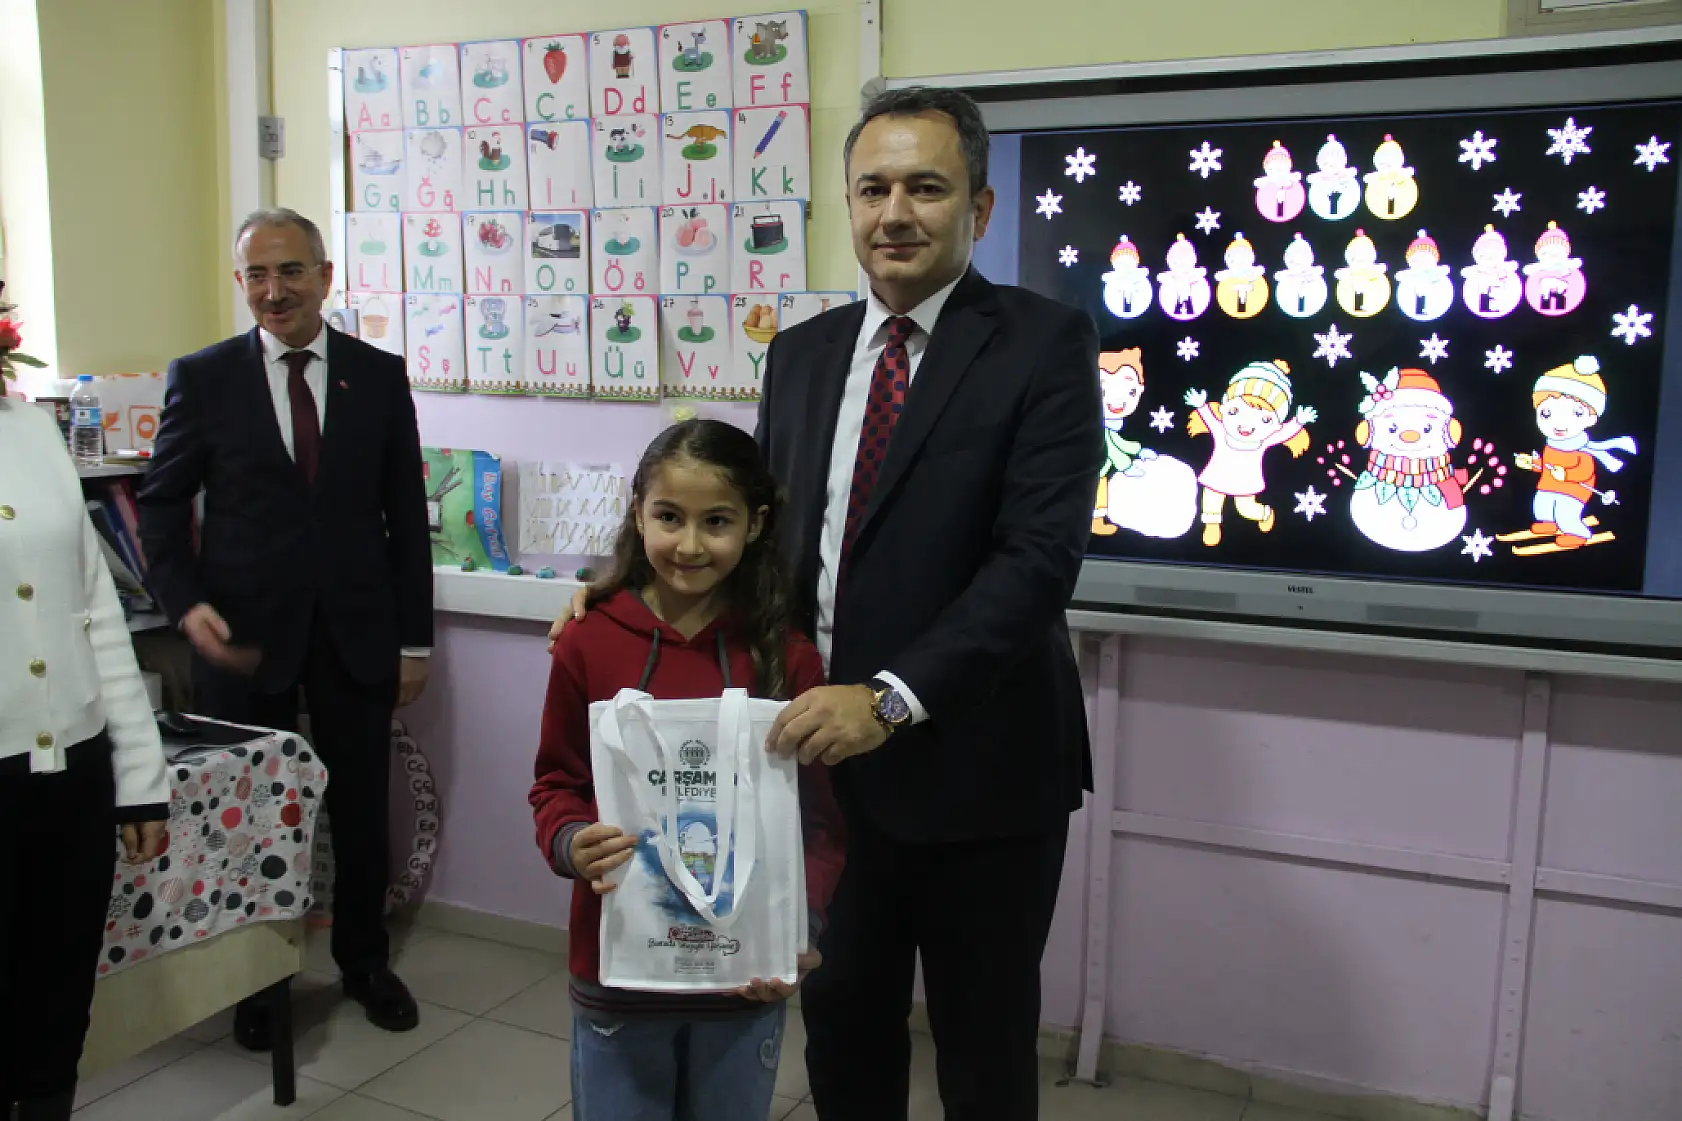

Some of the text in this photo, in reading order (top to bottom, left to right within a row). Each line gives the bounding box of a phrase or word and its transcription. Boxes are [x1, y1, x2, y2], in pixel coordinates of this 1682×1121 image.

[604, 85, 645, 115] D d
[677, 81, 717, 110] E e
[750, 72, 792, 104] F f
[358, 102, 373, 128] A
[416, 100, 451, 126] B b
[474, 97, 492, 123] C
[477, 179, 516, 206] H h
[752, 165, 794, 196] K k
[364, 183, 381, 208] G
[359, 263, 372, 288] L
[413, 264, 452, 291] M m
[475, 265, 512, 292] N n
[536, 264, 575, 291] O o
[604, 258, 624, 291] Ö
[676, 261, 717, 293] P p
[750, 260, 791, 289] R r
[477, 346, 513, 374] T t
[537, 348, 576, 376] U u
[604, 346, 624, 379] Ü
[677, 351, 719, 380] V v
[747, 351, 766, 380] Y
[415, 799, 435, 811] Dd
